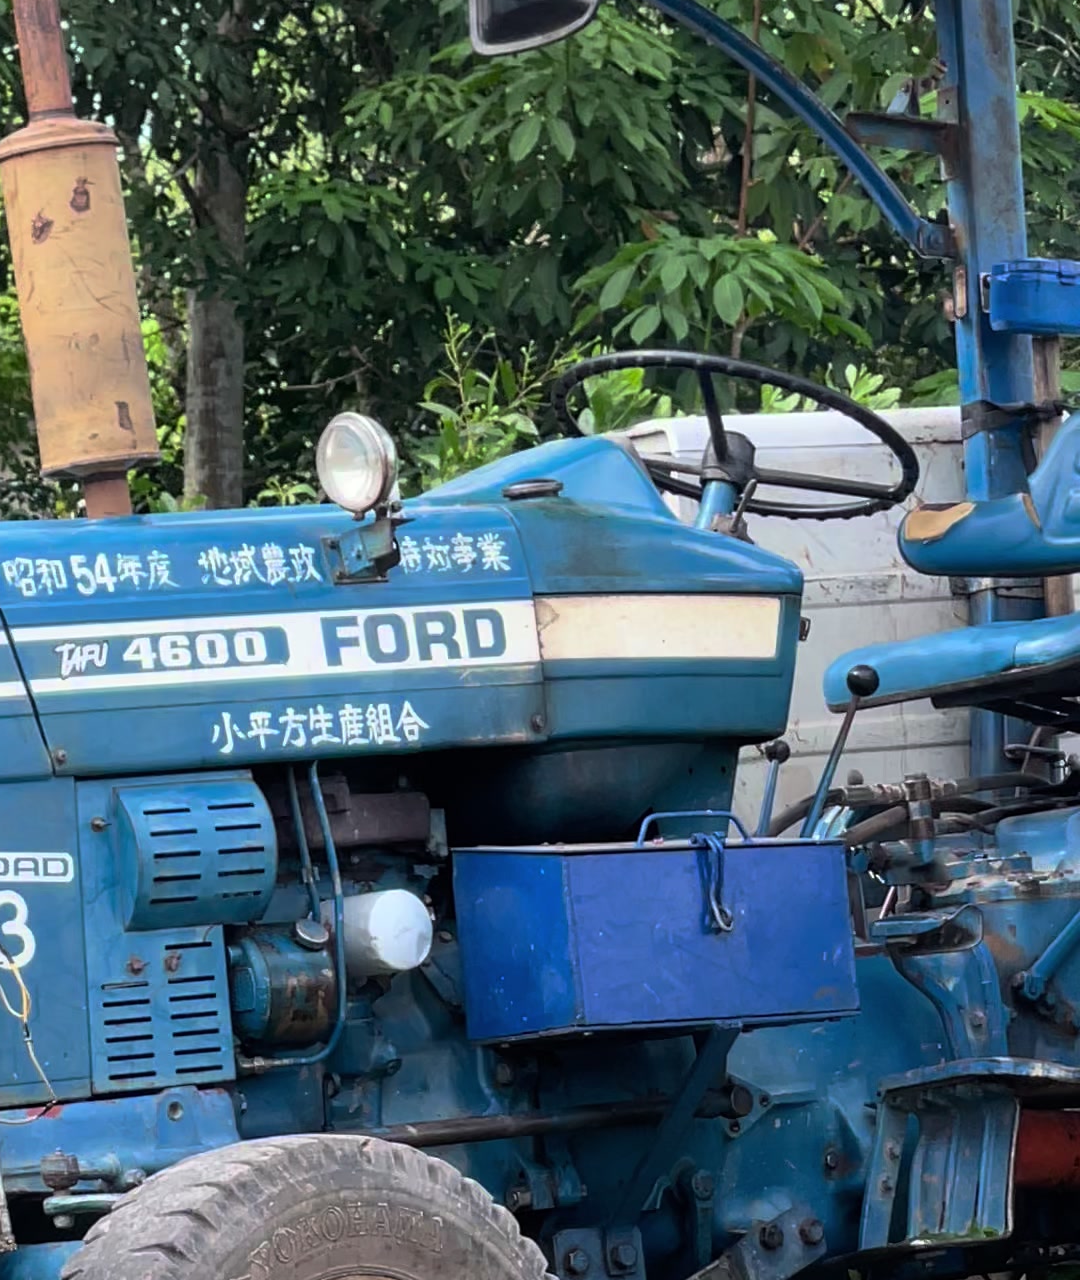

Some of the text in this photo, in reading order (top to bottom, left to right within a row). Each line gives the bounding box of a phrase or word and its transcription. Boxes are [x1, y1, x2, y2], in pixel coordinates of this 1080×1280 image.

[1, 549, 180, 597] 昭和54年度
[123, 630, 268, 670] 4600
[320, 608, 507, 667] FORD
[211, 700, 430, 754] 小平方生産組合
